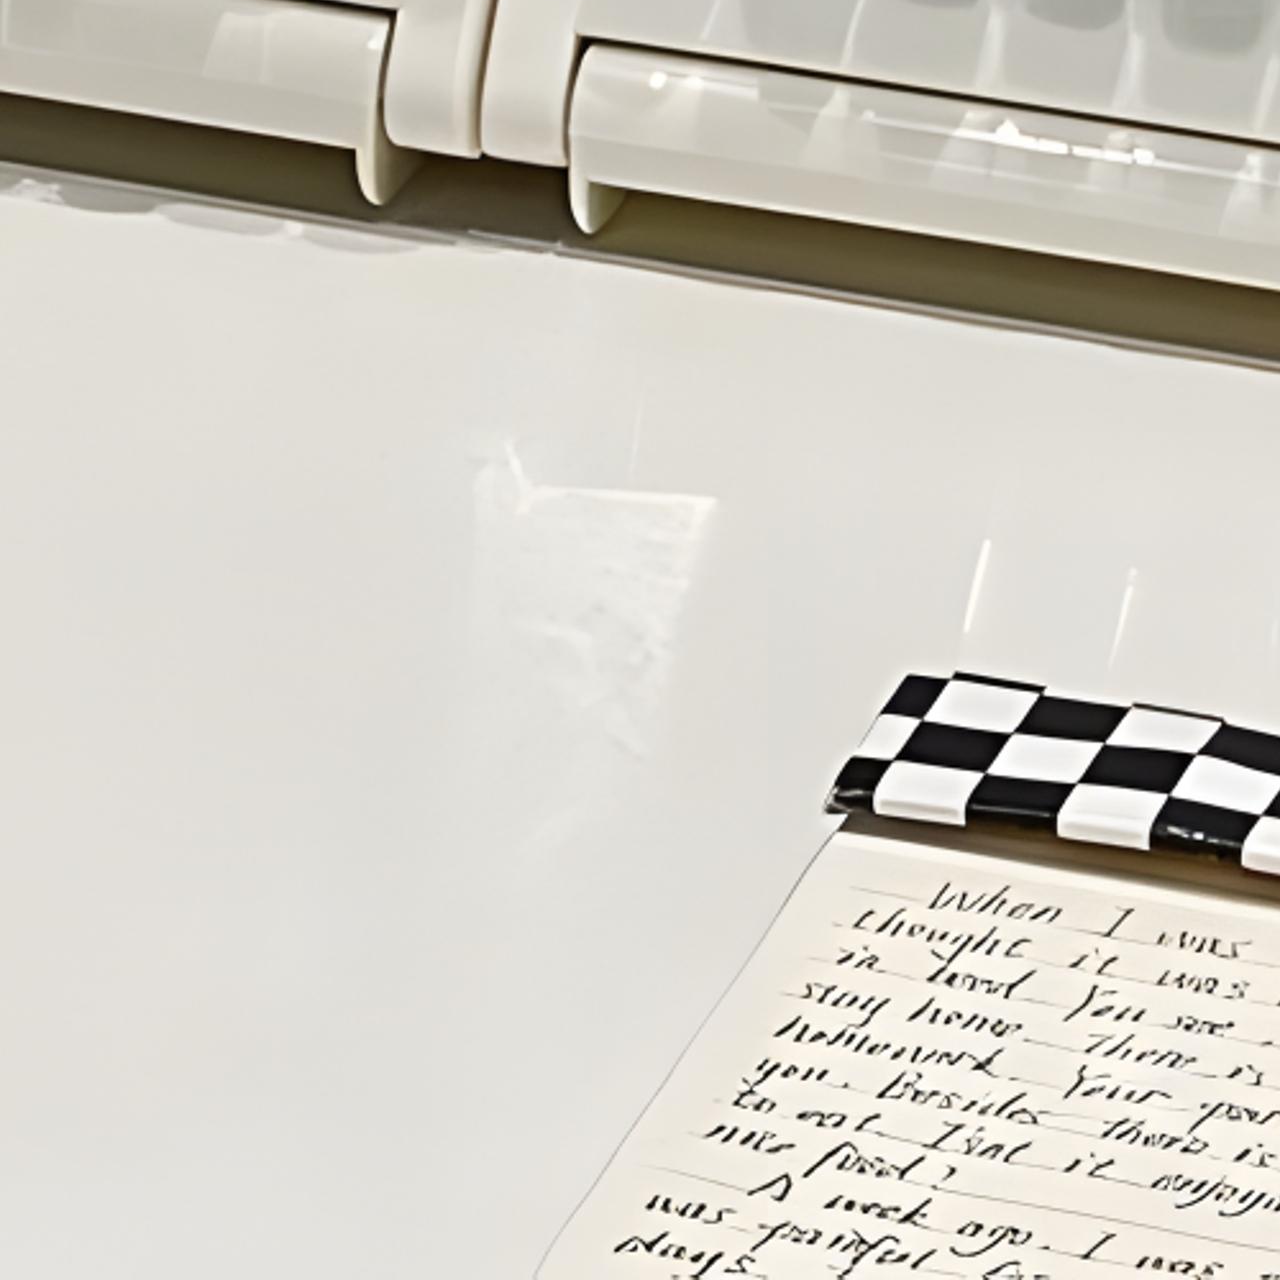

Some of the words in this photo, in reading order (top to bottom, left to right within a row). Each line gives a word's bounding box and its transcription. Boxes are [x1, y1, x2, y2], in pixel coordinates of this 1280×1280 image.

[836, 946, 880, 972] in
[853, 907, 1032, 964] thought
[1069, 947, 1119, 976] it
[1156, 969, 1250, 1000] was
[928, 882, 1063, 924] When
[1104, 906, 1135, 937] I
[1156, 931, 1252, 958] was
[800, 983, 891, 1028] stay
[1228, 1064, 1264, 1086] is
[1063, 1064, 1172, 1099] Your
[732, 1087, 777, 1114] to
[1063, 1154, 1114, 1178] it
[1234, 1144, 1276, 1168] is
[747, 1173, 792, 1201] A
[1080, 1232, 1116, 1259] I
